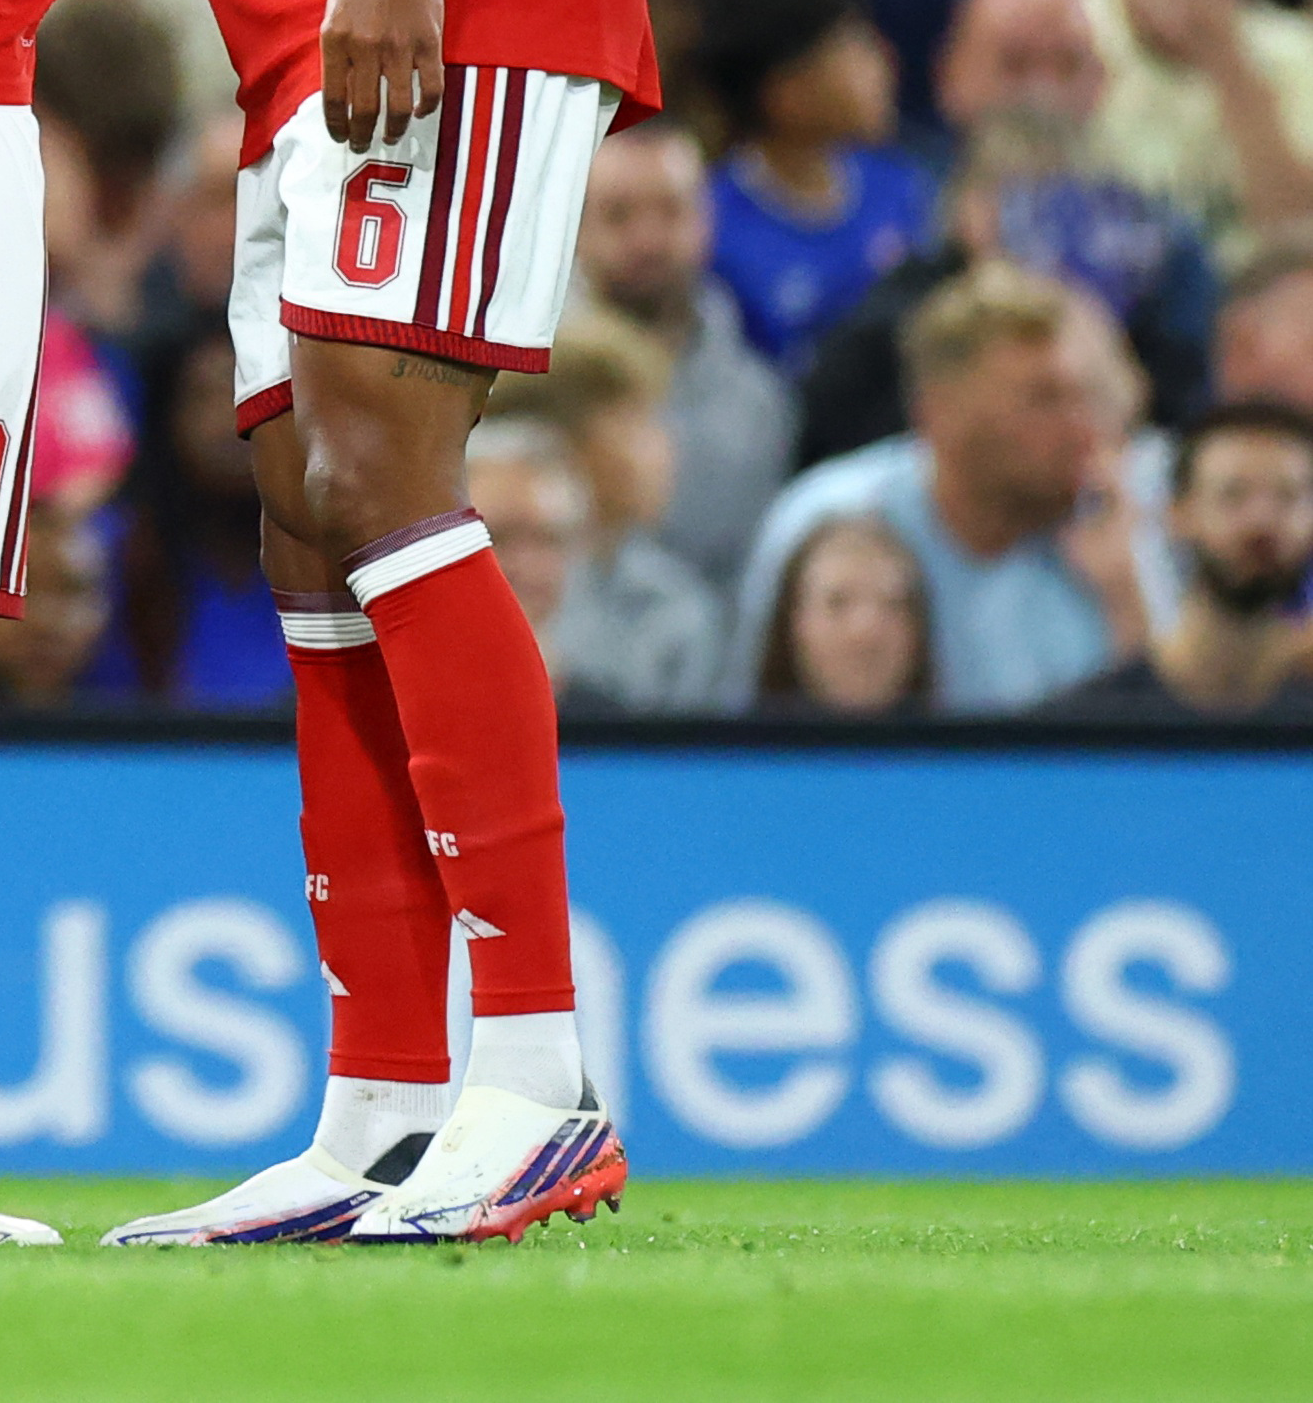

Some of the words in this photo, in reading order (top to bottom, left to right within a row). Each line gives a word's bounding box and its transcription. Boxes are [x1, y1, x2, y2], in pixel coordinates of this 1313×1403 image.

[333, 159, 413, 289] 6
[425, 829, 459, 857] FC
[305, 874, 329, 901] FC
